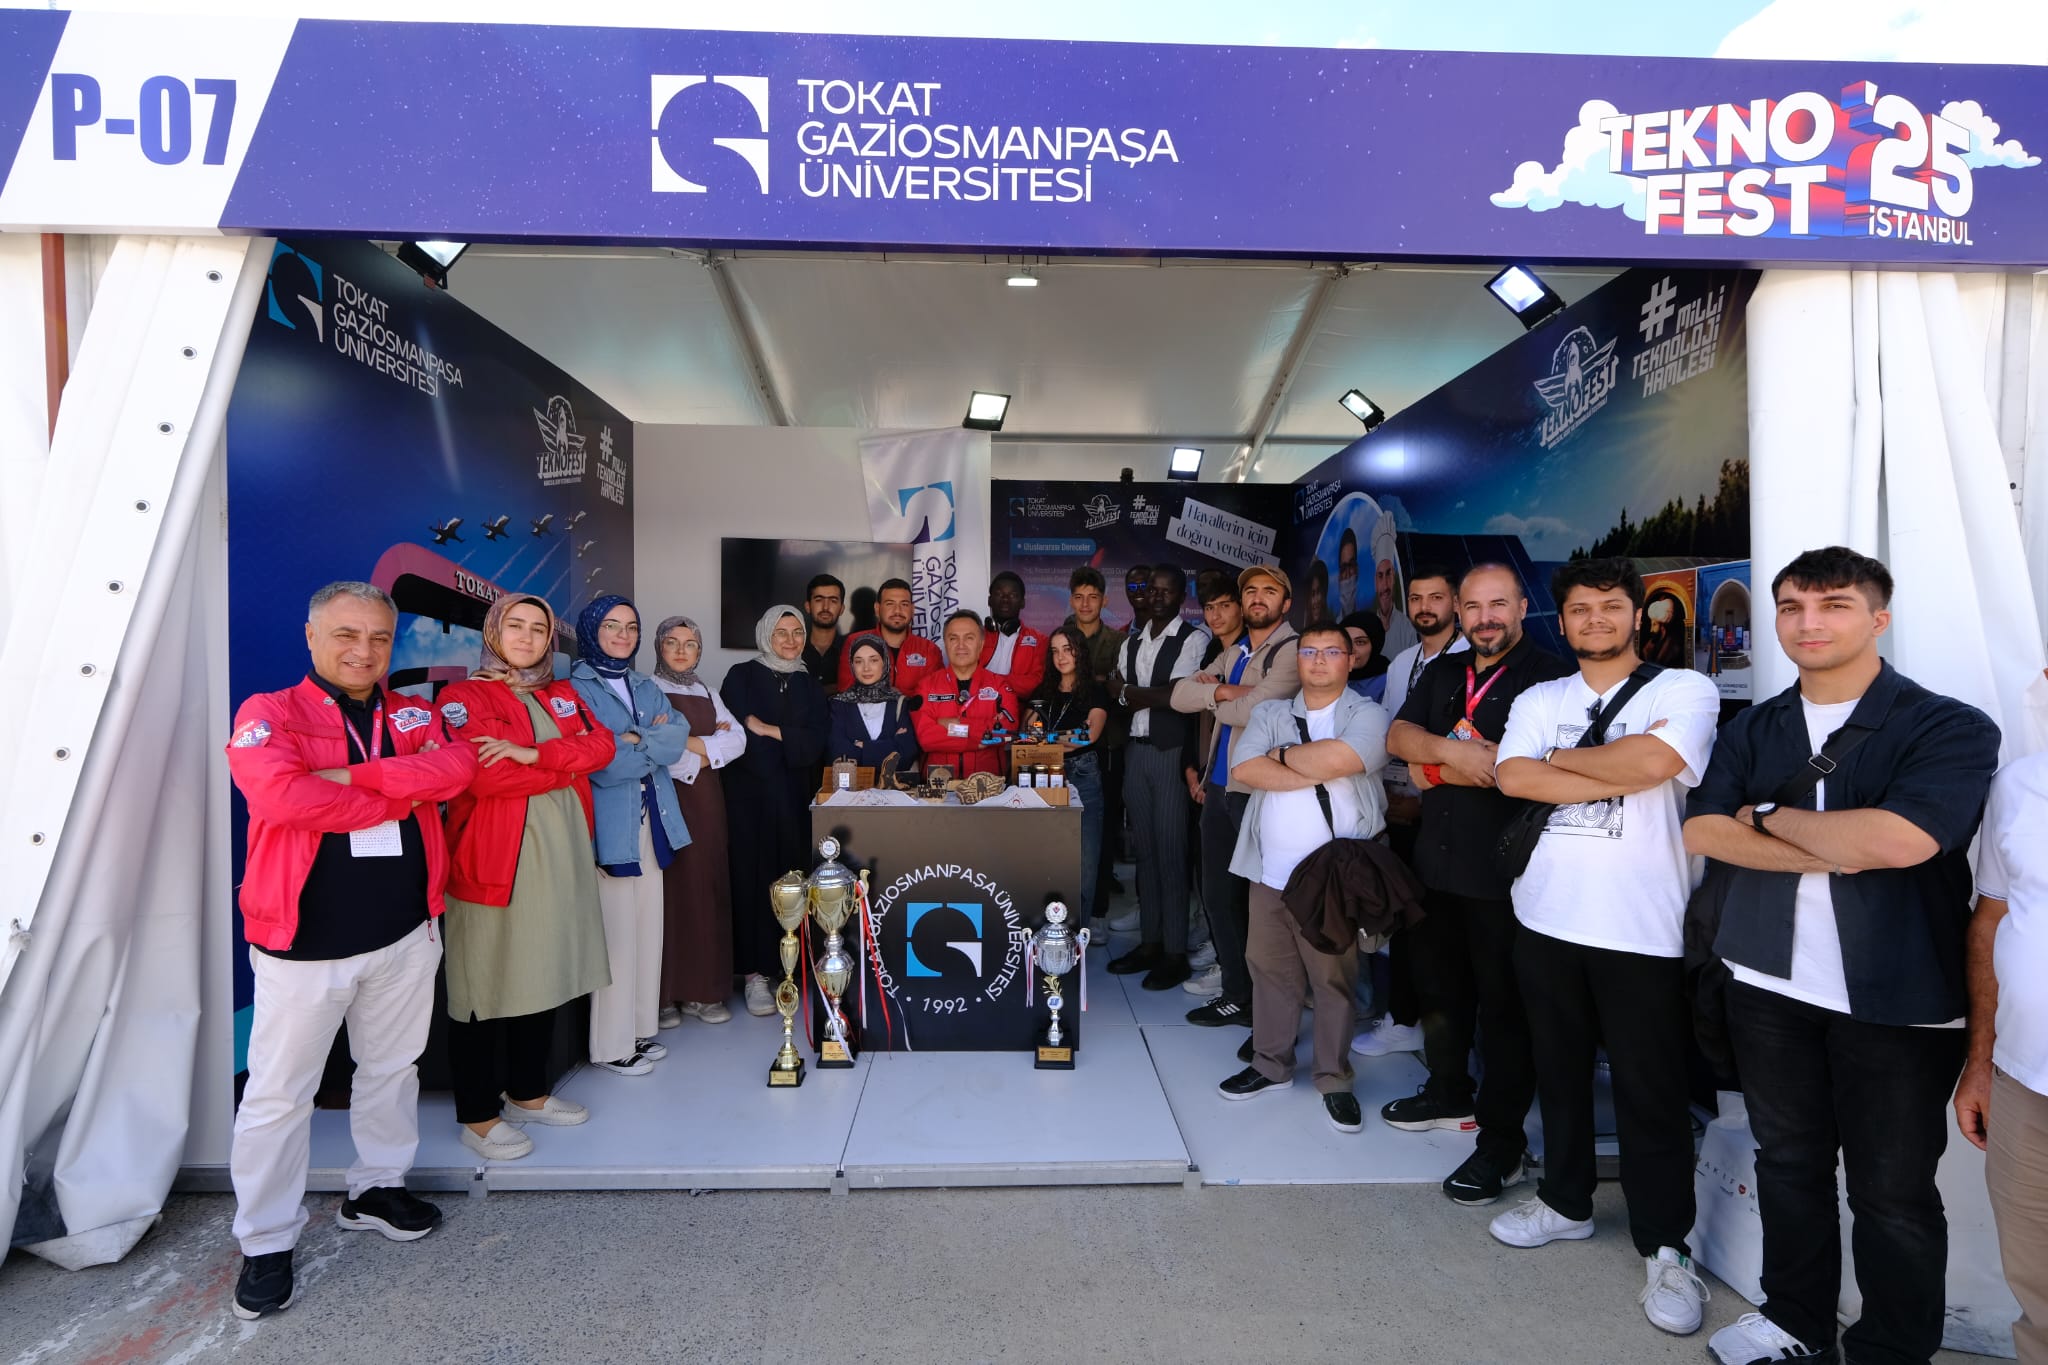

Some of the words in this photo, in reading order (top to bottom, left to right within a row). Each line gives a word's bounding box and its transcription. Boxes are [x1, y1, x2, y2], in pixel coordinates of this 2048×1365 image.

[51, 73, 236, 165] P-07
[797, 79, 941, 116] TOKAT
[796, 118, 1179, 168] GAZİOSMANPAŞA
[1600, 91, 1835, 173] TEKNO
[799, 158, 1092, 203] ÜNİVERSİTESİ
[1645, 164, 1828, 237] FEST
[333, 273, 389, 323] TOKAT
[333, 302, 463, 389] GAZİOSMANPAŞA
[334, 326, 439, 398] ÜNİVERSİTESİ
[1632, 313, 1721, 380] TEKNOLOJİ
[1642, 340, 1717, 399] HAMLESİ
[1538, 355, 1620, 448] TEKNOFEST
[536, 449, 587, 480] TEKNOFEST
[1176, 523, 1213, 549] doğru
[1211, 540, 1265, 566] yerdesin
[1187, 504, 1245, 538] Hayallerin
[1247, 526, 1269, 547] için
[456, 570, 500, 603] TOKAT
[985, 890, 1024, 1002] ÜNİVERSİTESİ
[923, 997, 968, 1015] 1992
